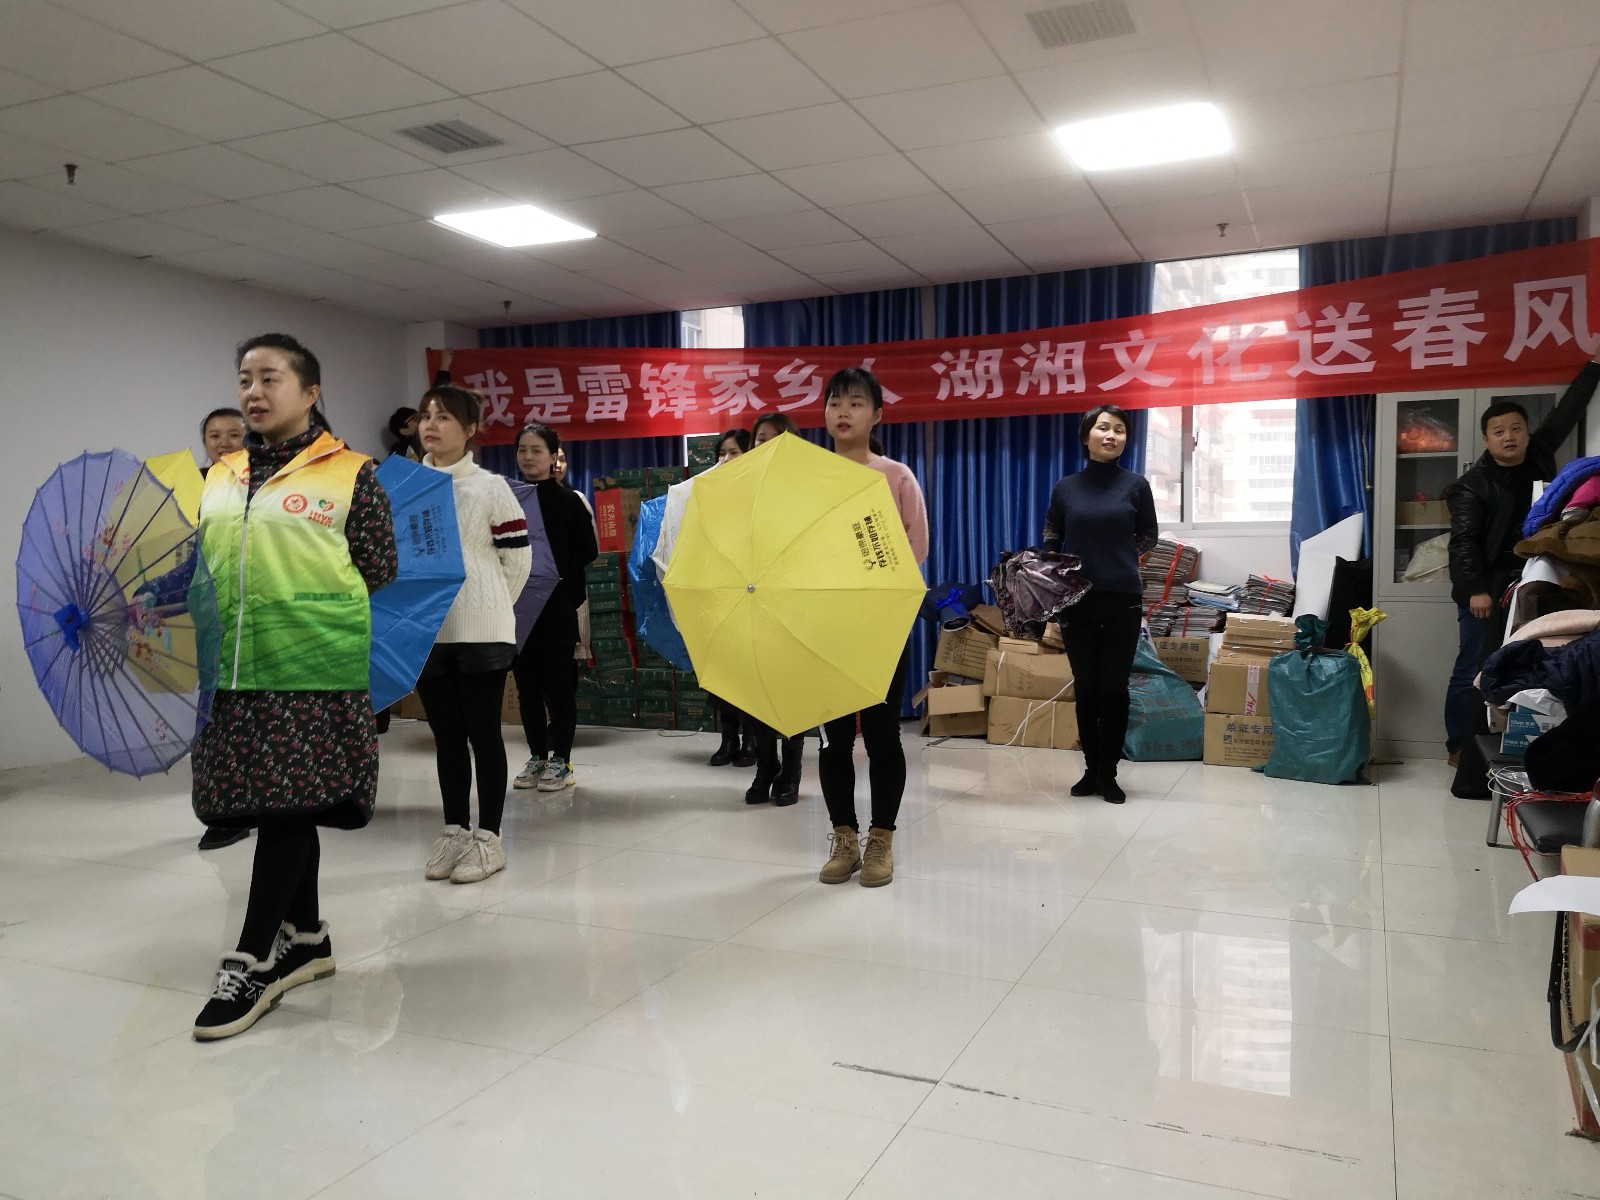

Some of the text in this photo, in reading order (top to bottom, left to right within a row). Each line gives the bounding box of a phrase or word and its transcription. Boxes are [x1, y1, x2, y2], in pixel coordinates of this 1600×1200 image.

[930, 275, 1598, 401] 湖湘文化送春风
[1154, 641, 1200, 652] 证专用箱
